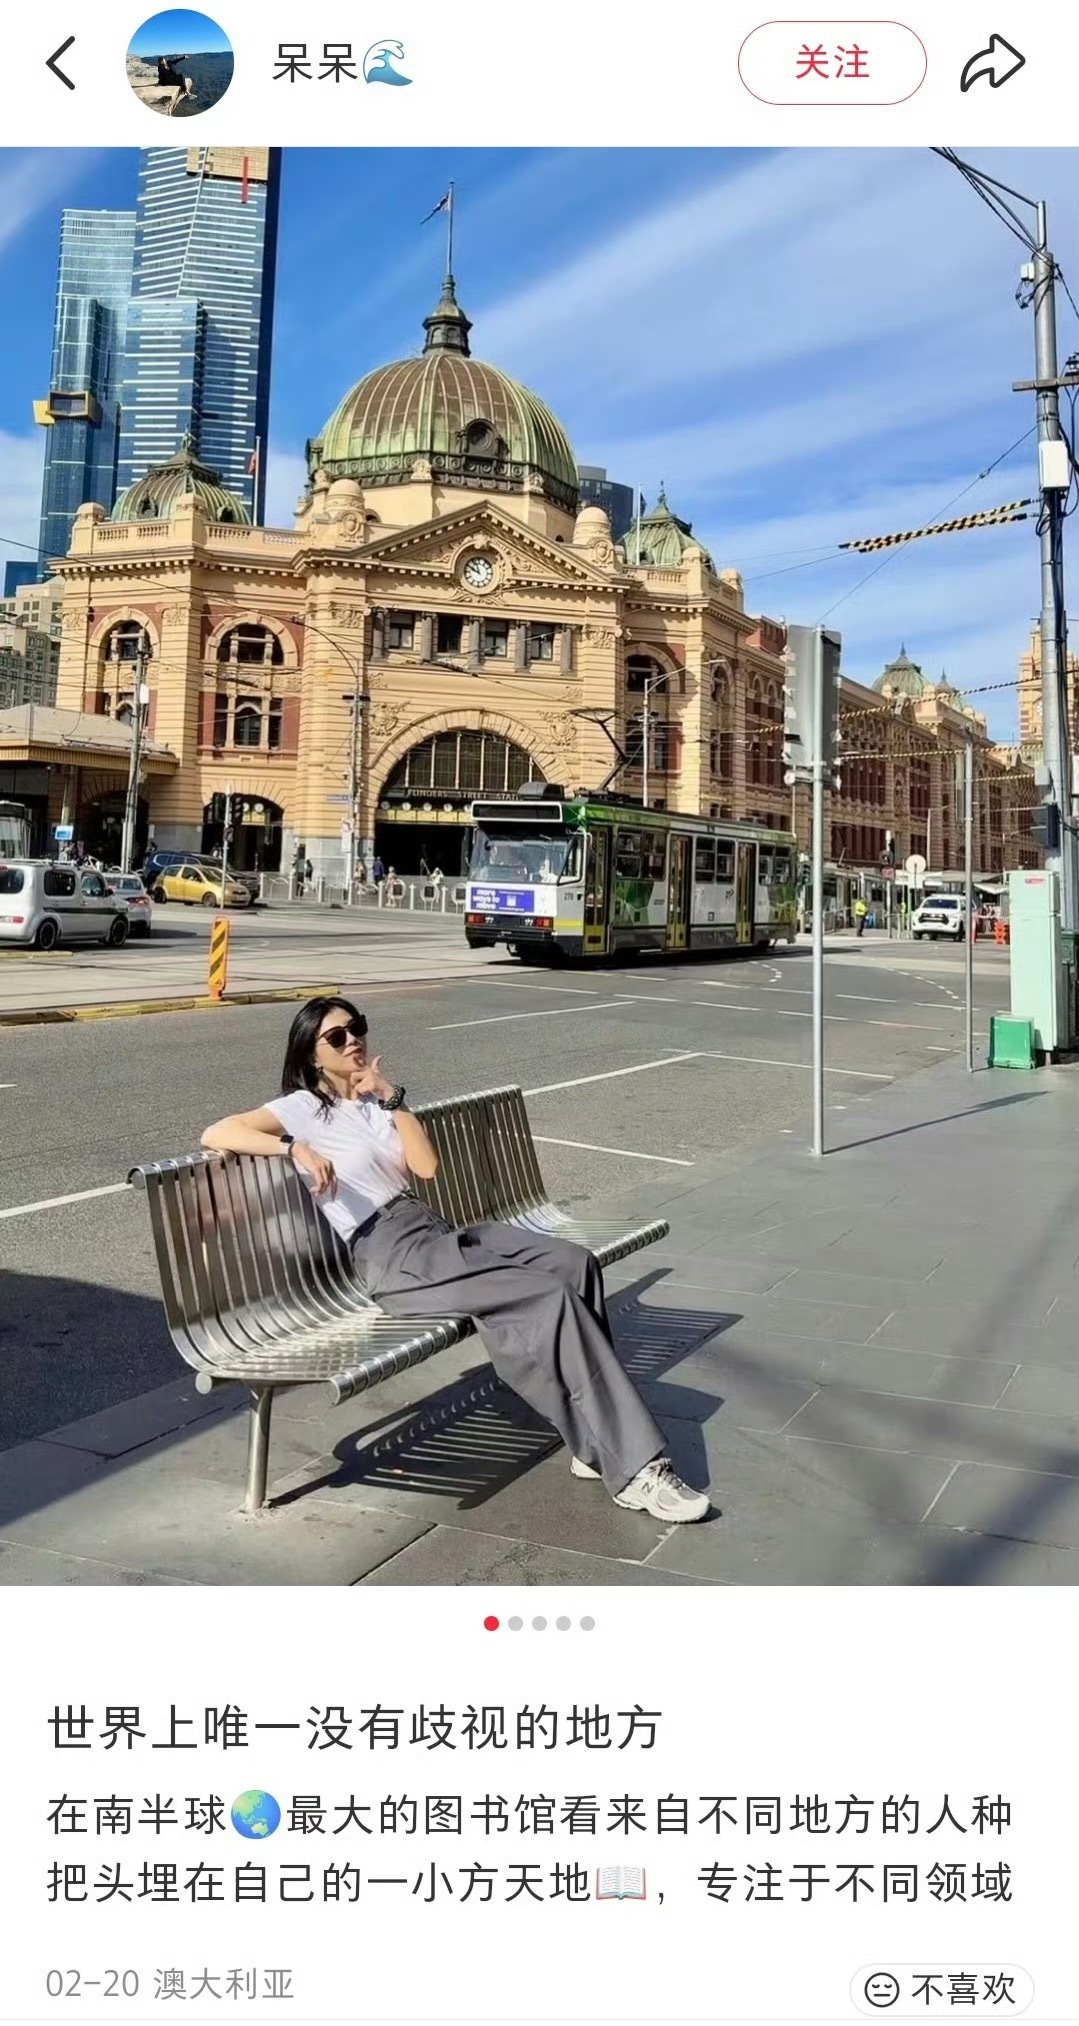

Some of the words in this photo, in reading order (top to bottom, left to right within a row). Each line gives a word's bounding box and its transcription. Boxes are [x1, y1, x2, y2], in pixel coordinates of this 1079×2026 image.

[457, 790, 487, 799] STREET
[496, 792, 519, 802] STATI
[641, 1482, 655, 1495] N
